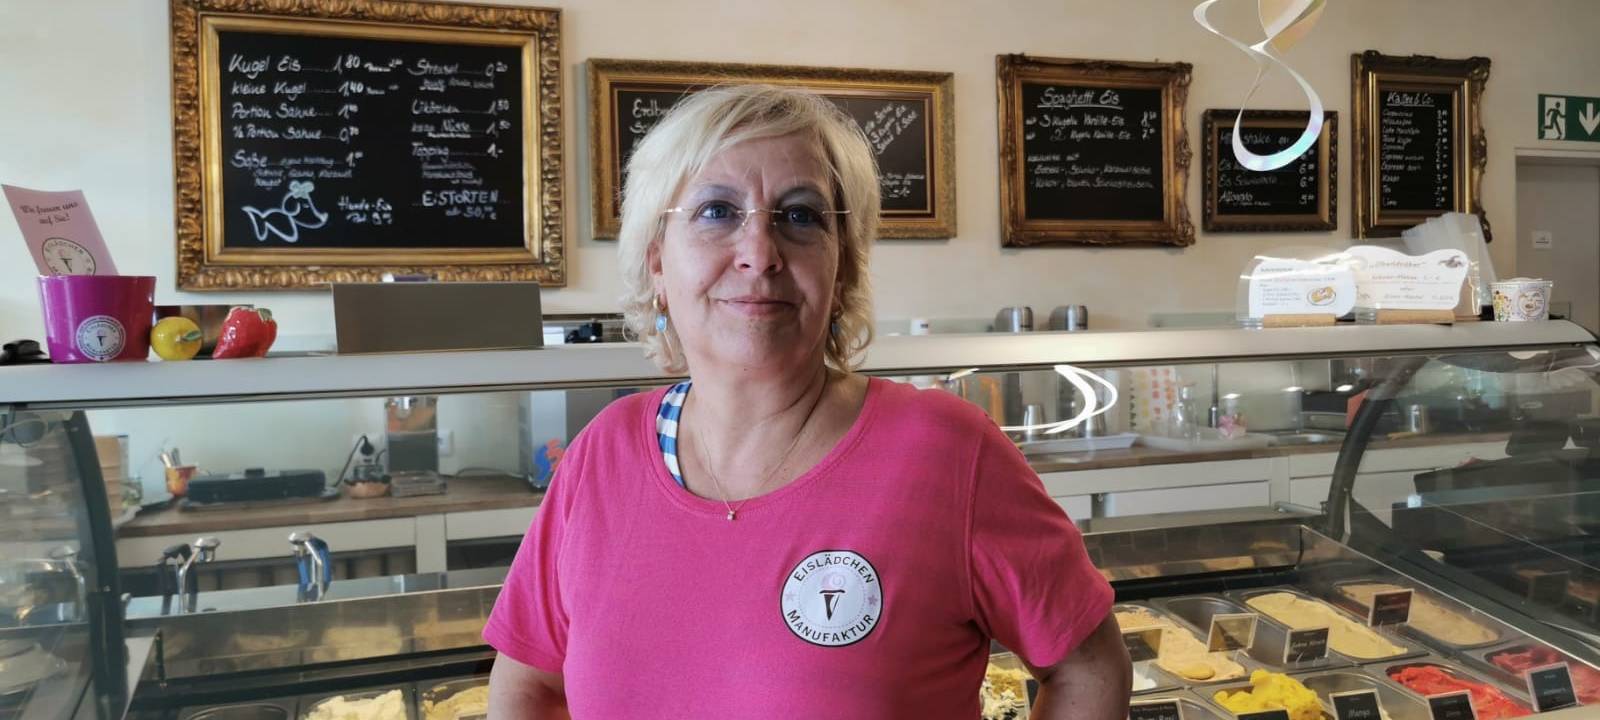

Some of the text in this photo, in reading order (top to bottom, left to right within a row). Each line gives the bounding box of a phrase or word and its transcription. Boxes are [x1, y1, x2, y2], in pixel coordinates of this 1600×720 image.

[228, 54, 270, 79] Kugel
[277, 55, 302, 73] Eis
[407, 58, 459, 76] Streusel
[231, 81, 267, 95] kleine
[273, 82, 306, 101] Kugel
[1040, 87, 1120, 110] Spaghetti Eis
[232, 102, 272, 119] Portion
[275, 102, 317, 118] Sahne
[1039, 114, 1050, 127] 3
[246, 124, 279, 138] Portion
[282, 126, 321, 140] Sahne
[1051, 129, 1065, 141] 2
[794, 553, 874, 584] EISLÄDCHEN
[787, 609, 874, 642] MANUFAKTUR
